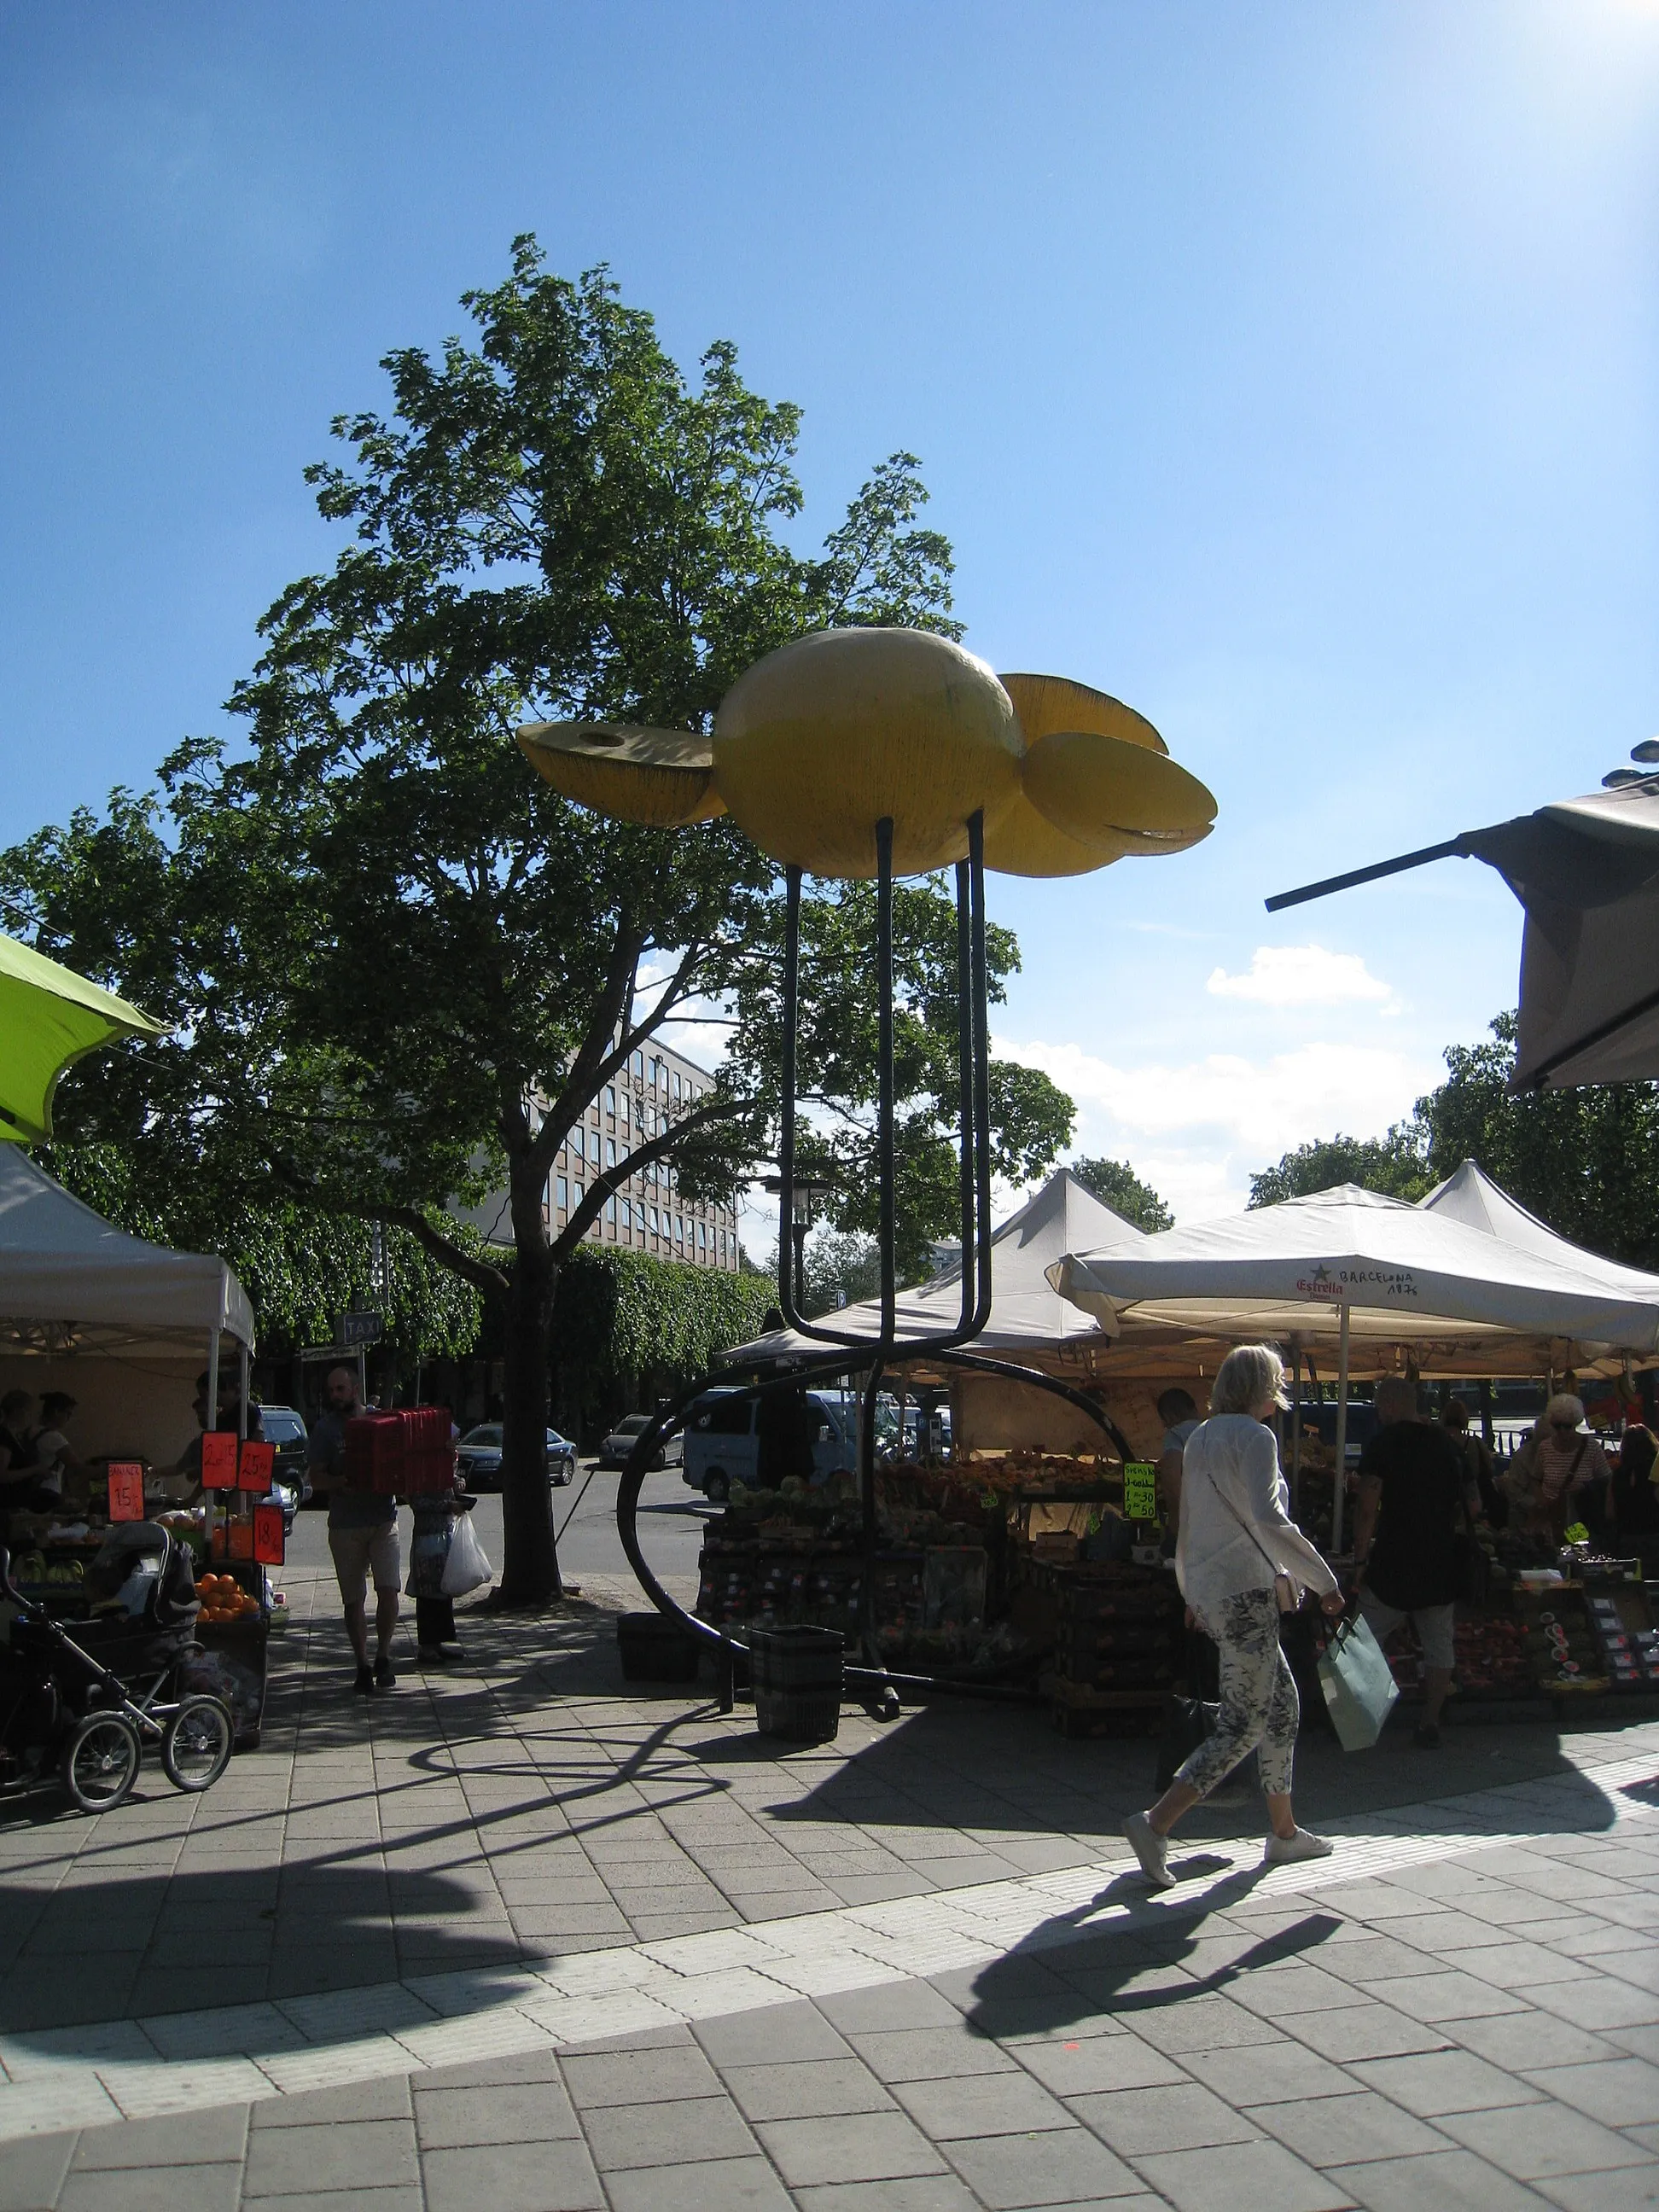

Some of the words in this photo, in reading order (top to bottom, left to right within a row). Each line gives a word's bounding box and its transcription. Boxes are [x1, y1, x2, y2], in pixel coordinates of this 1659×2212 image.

[1340, 1271, 1413, 1284] BARCELONA
[1296, 1279, 1343, 1295] Estrella
[347, 1320, 380, 1336] TAXI
[242, 1452, 259, 1476] 25
[114, 1487, 131, 1507] 15
[1140, 1492, 1154, 1503] 30
[1141, 1505, 1155, 1516] 50
[258, 1520, 271, 1545] 18
